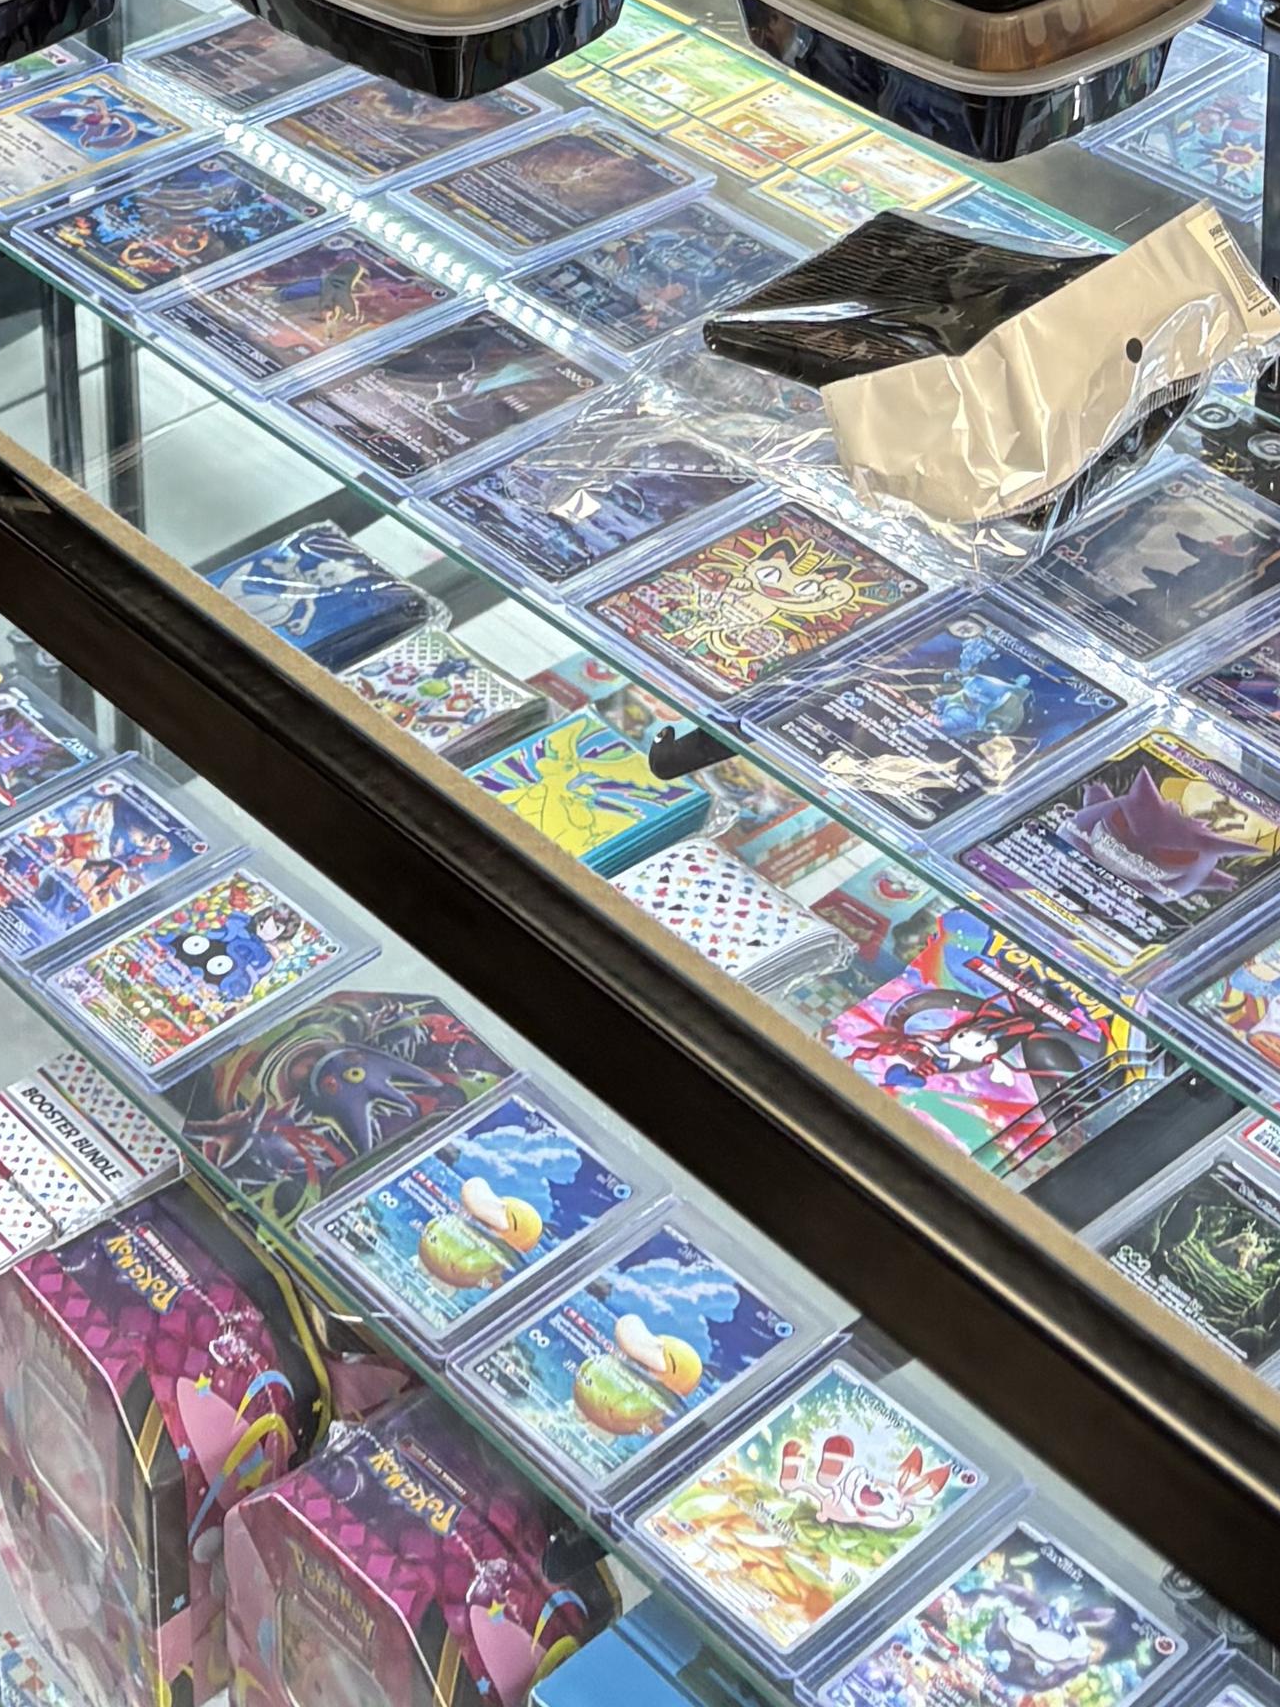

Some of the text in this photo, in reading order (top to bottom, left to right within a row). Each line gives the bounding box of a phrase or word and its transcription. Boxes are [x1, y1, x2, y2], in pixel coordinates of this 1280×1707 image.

[1017, 986, 1044, 1008] CARD
[1042, 1005, 1072, 1026] GAME
[22, 1085, 125, 1184] BOOSTER BUNDLE
